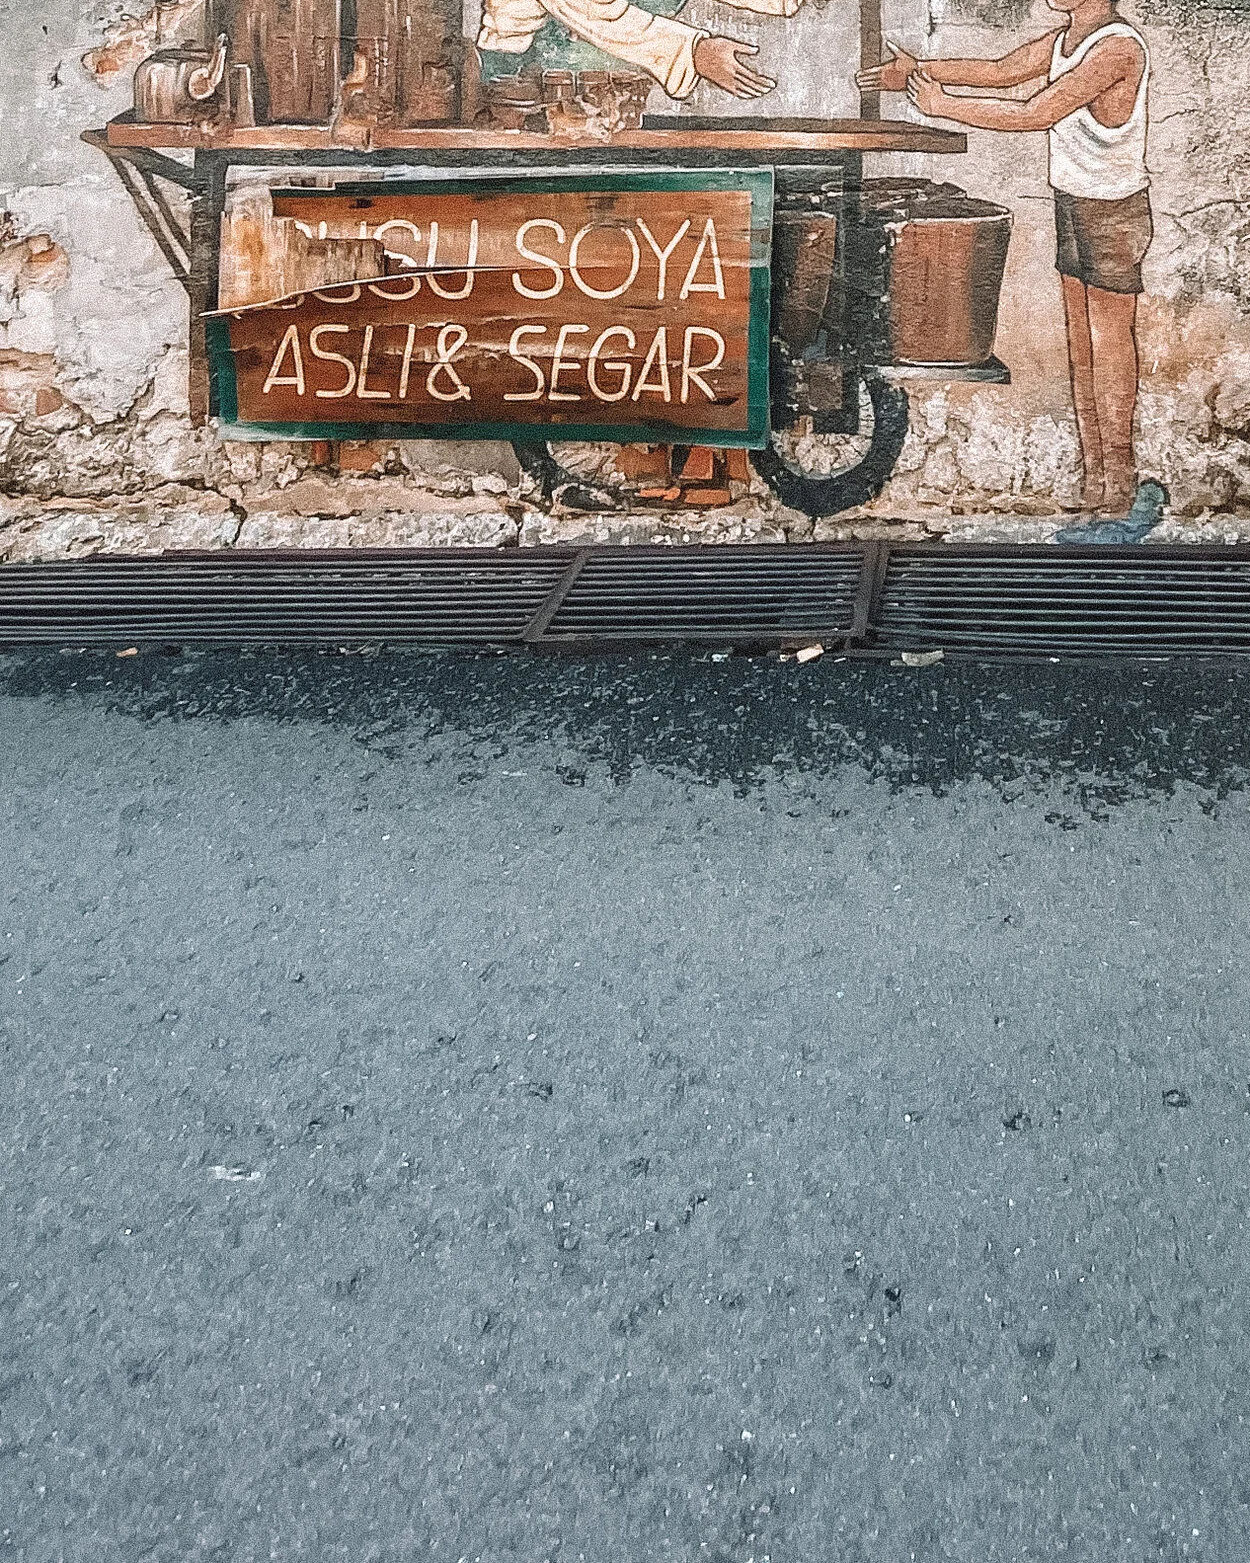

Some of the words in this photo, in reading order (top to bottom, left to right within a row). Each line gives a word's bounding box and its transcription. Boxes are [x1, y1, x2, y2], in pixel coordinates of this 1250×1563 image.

[513, 217, 727, 302] SOYA
[262, 323, 417, 400] ASLI
[426, 323, 472, 401] &
[503, 324, 727, 404] SEGAR
